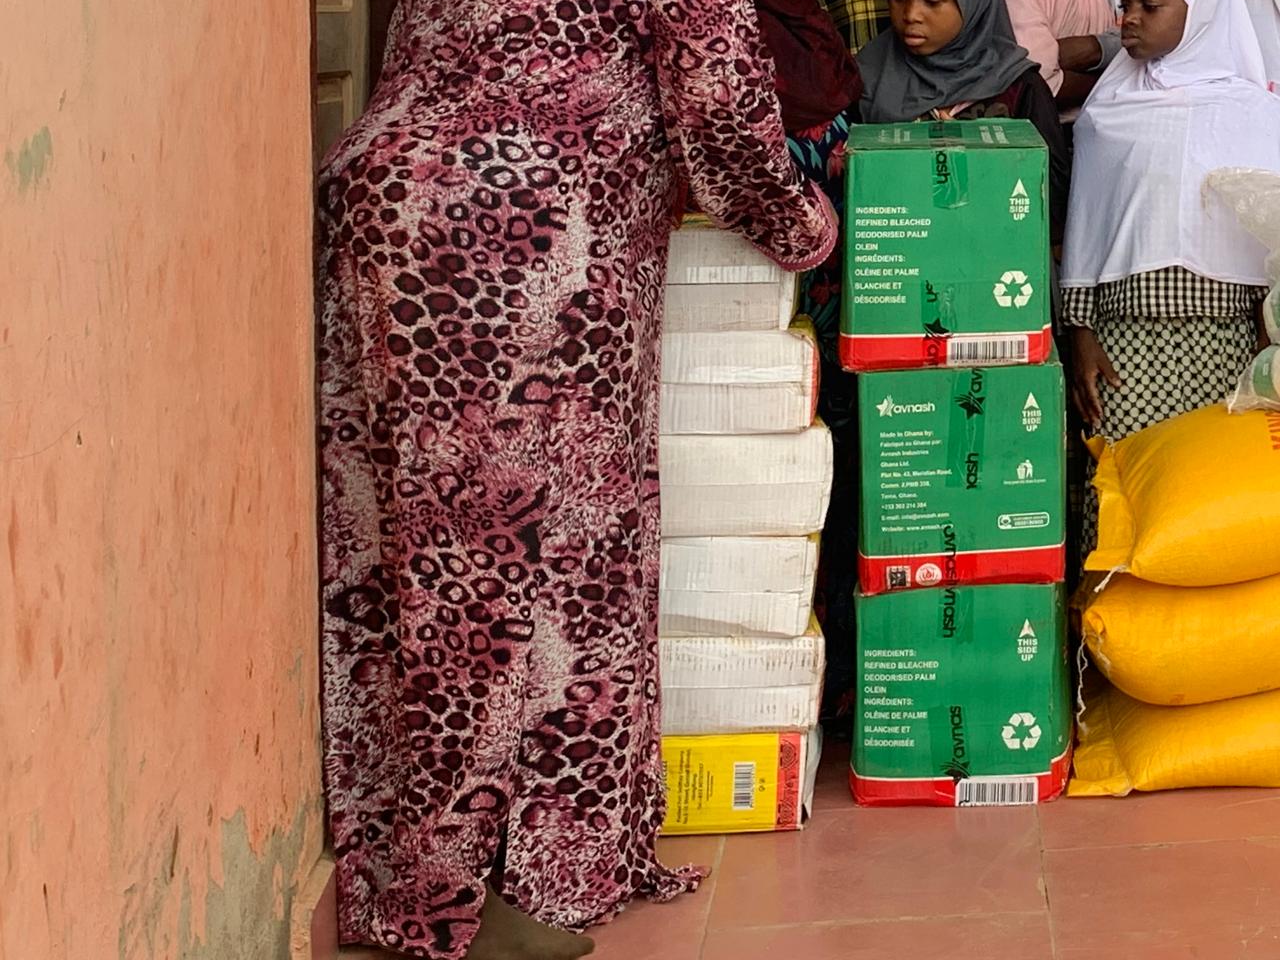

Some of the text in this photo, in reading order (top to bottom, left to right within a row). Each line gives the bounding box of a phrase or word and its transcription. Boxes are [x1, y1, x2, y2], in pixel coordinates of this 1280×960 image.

[1010, 197, 1030, 205] THIS
[1010, 205, 1030, 213] SIDE
[1013, 213, 1025, 221] UP
[890, 218, 931, 226] BLEACHED
[883, 268, 893, 276] DE
[894, 268, 919, 276] PALME
[893, 402, 936, 414] avnash
[1022, 417, 1041, 425] SIDE
[1025, 424, 1038, 432] UP
[1017, 638, 1038, 646] THIS
[864, 649, 917, 657] INGREDIENTS:
[1017, 646, 1038, 654] SIDE
[1021, 654, 1034, 662] UP
[864, 661, 939, 669] REFINED BLEACHED
[864, 673, 936, 681] DEODORISED PALM
[891, 711, 902, 719] DE
[902, 711, 928, 719] PALME
